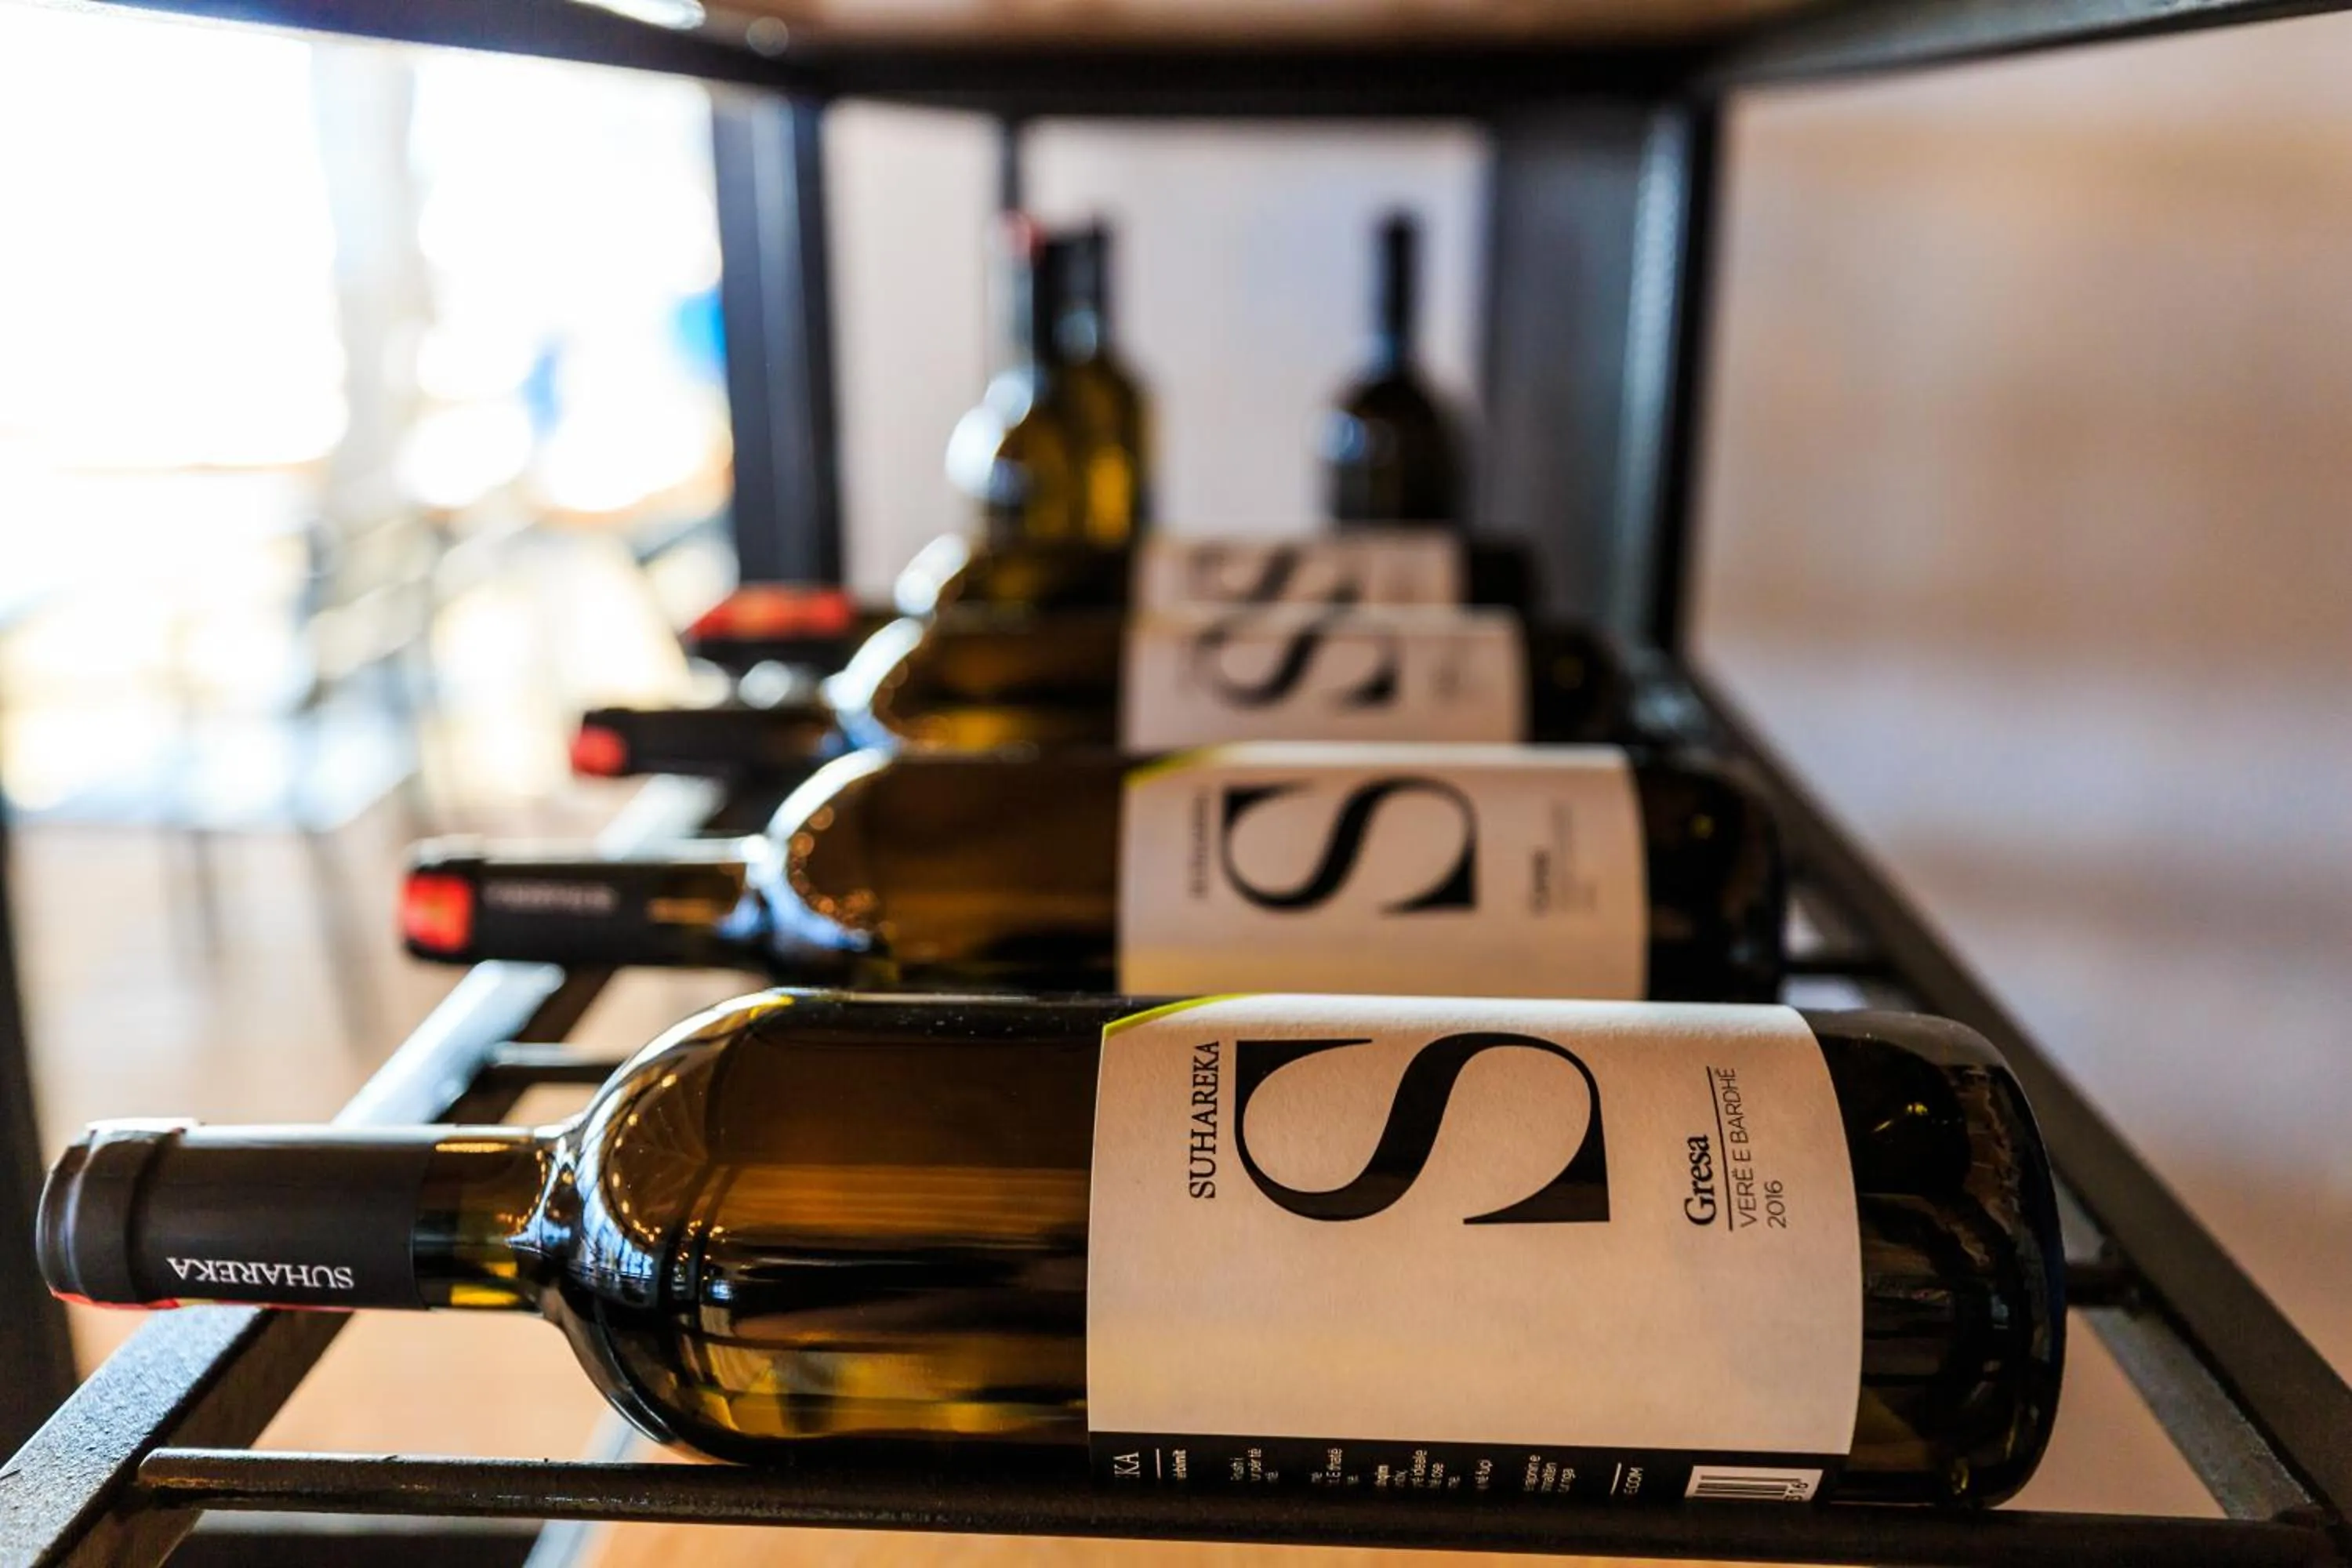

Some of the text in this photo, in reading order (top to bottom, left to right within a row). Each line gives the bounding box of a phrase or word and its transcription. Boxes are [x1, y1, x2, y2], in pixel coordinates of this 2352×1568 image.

[1221, 775, 1479, 916] S
[1189, 1040, 1220, 1200] SUHAREKA
[1234, 1031, 1611, 1225] S
[1732, 1149, 1751, 1162] E
[1684, 1134, 1717, 1226] Gresa
[1732, 1167, 1758, 1229] VERË
[1764, 1179, 1788, 1229] 2016
[166, 1257, 354, 1289] SUHAREKA
